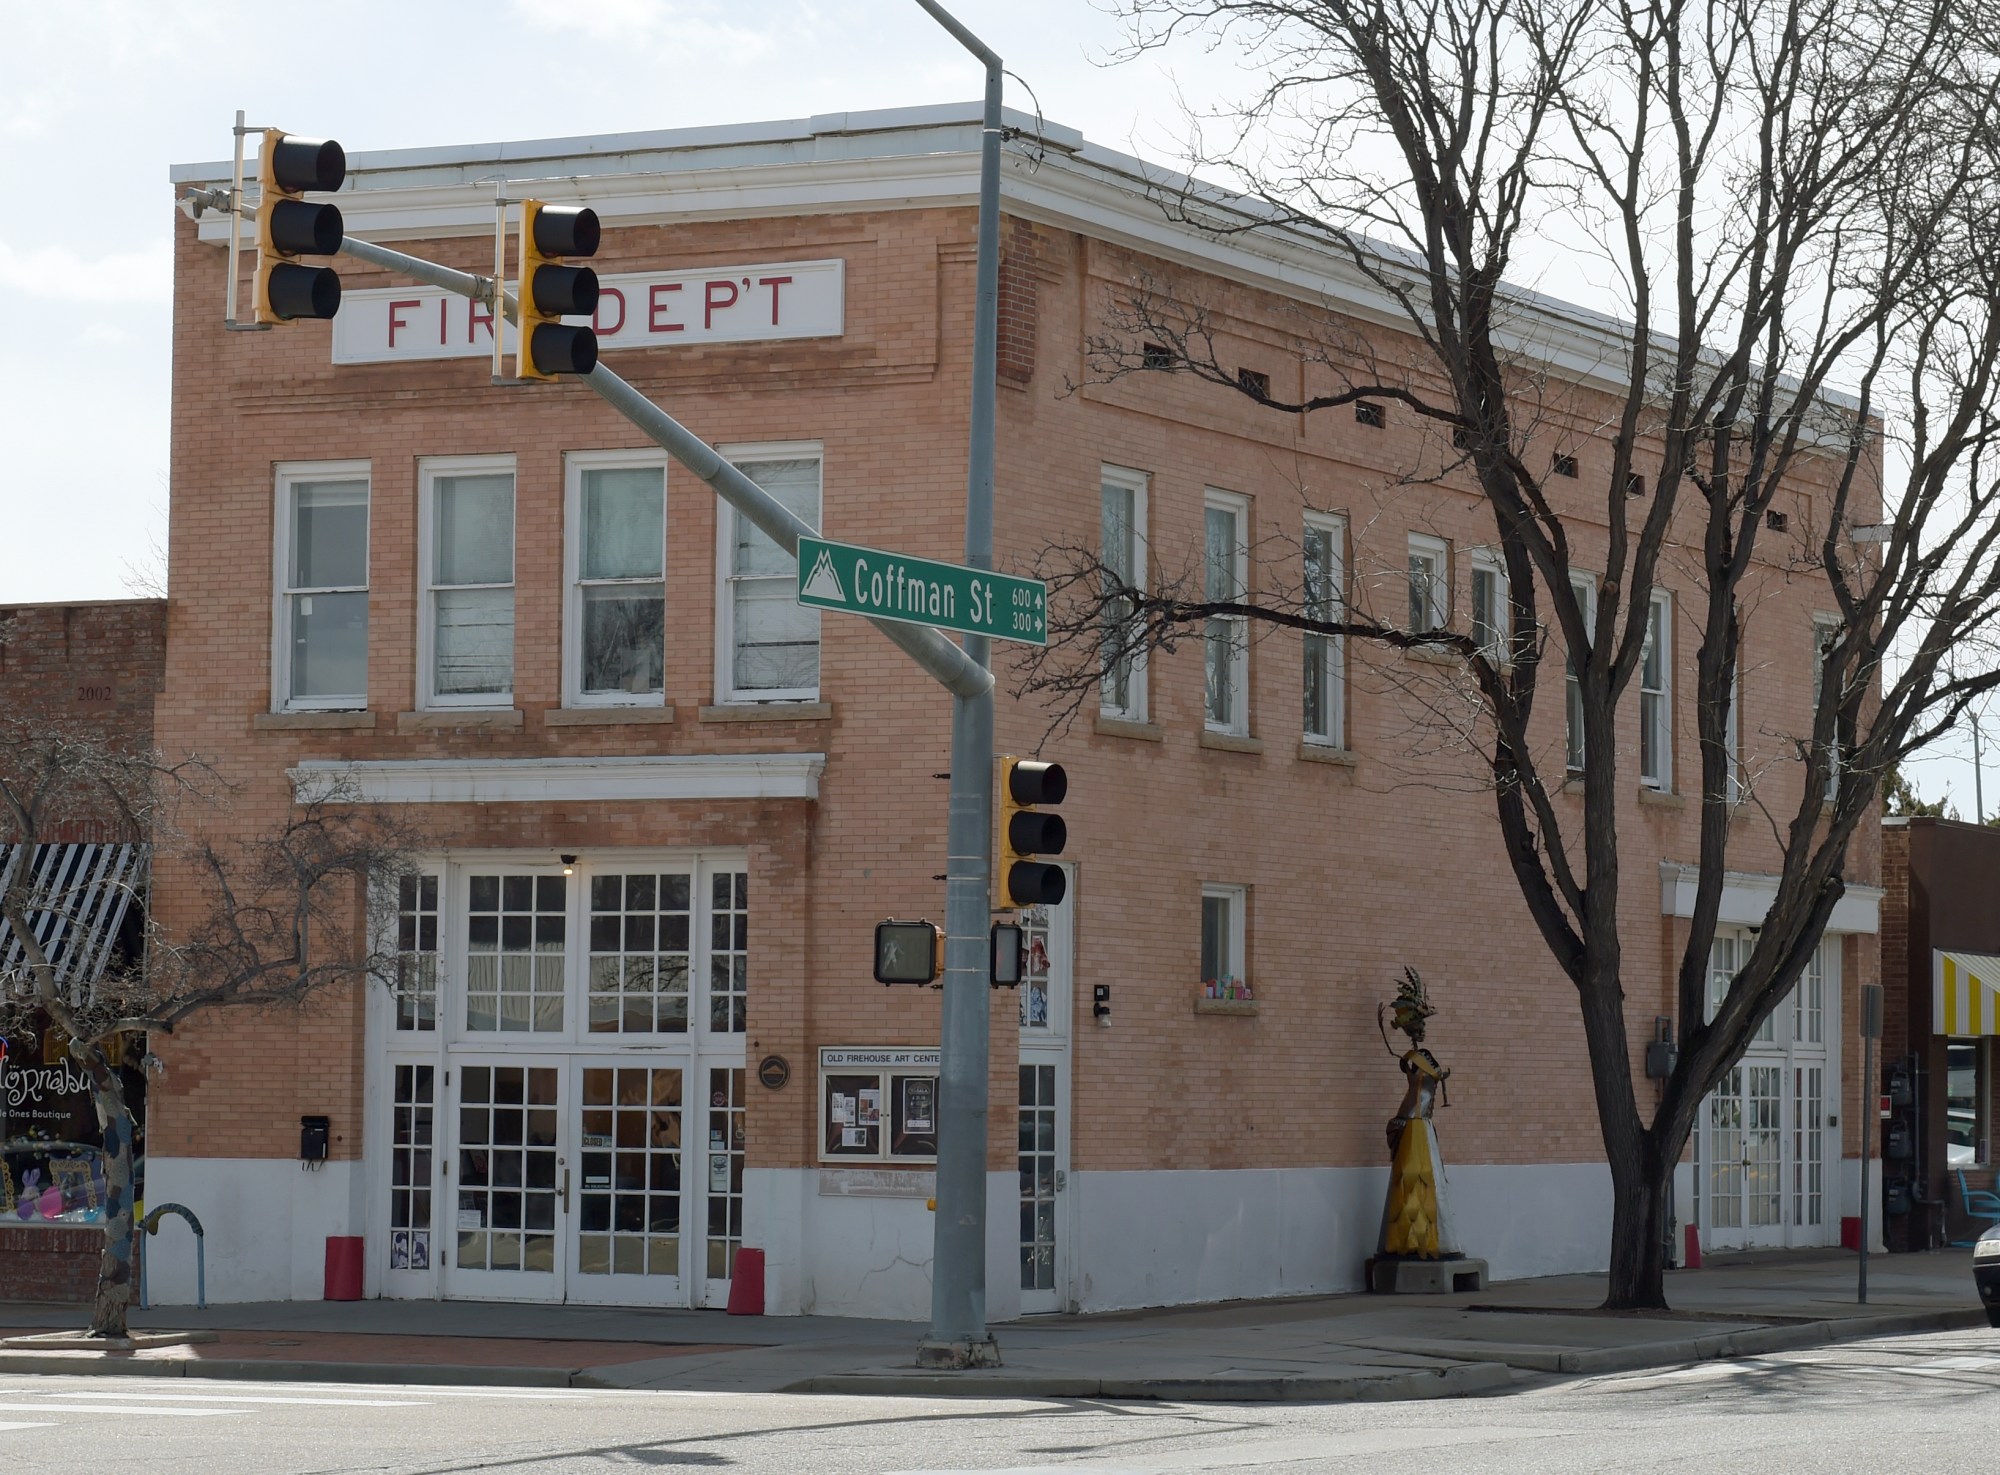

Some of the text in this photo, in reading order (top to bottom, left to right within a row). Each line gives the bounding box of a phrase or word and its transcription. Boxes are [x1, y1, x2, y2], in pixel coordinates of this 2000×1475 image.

[389, 276, 793, 348] FIR DEP'T
[854, 558, 993, 625] Coffman St
[1012, 588, 1031, 608] 600
[1012, 613, 1031, 632] 300
[78, 686, 112, 701] 2002
[827, 1054, 940, 1063] OLD FIREHOUSE ART CENTE
[9, 1109, 30, 1118] Ones
[32, 1109, 72, 1121] Boutique
